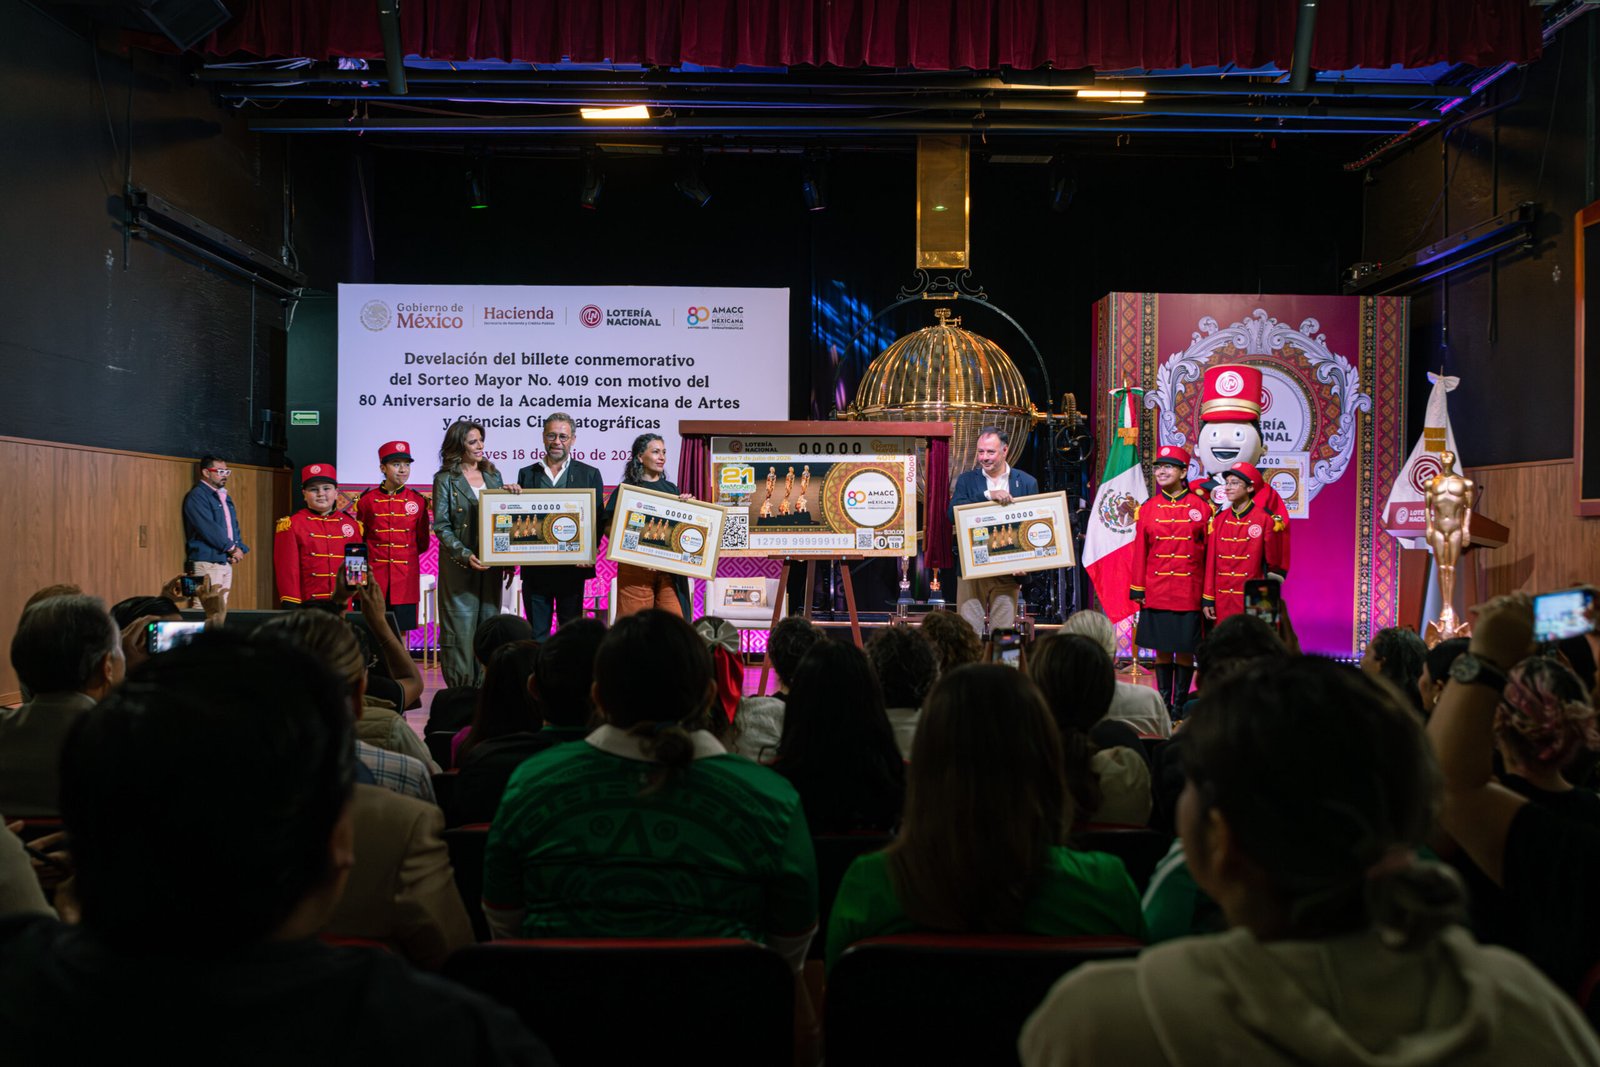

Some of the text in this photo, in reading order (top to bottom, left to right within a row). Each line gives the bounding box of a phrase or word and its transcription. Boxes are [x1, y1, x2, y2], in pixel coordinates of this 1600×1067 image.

[397, 303, 464, 312] Gobierno de
[484, 306, 554, 320] Hacienda
[606, 307, 652, 317] LOTERÍA
[712, 306, 744, 314] AMACC
[397, 313, 463, 329] México
[606, 318, 661, 327] NACIONAL
[687, 306, 710, 325] 80
[404, 352, 695, 367] Develación del billete conmemorativo
[389, 373, 709, 389] del Sorteo Mayor No. 4019 con motivo del
[359, 394, 740, 409] 80 Aniversario de la Academia Mexicana de Artes
[443, 418, 452, 431] y
[526, 415, 660, 432] Ciatográficas
[513, 449, 525, 460] 18
[530, 448, 547, 460] de
[590, 449, 606, 460] de
[611, 450, 634, 461] 202
[799, 442, 861, 455] 00000
[722, 468, 754, 484] 21
[847, 491, 866, 506] 80
